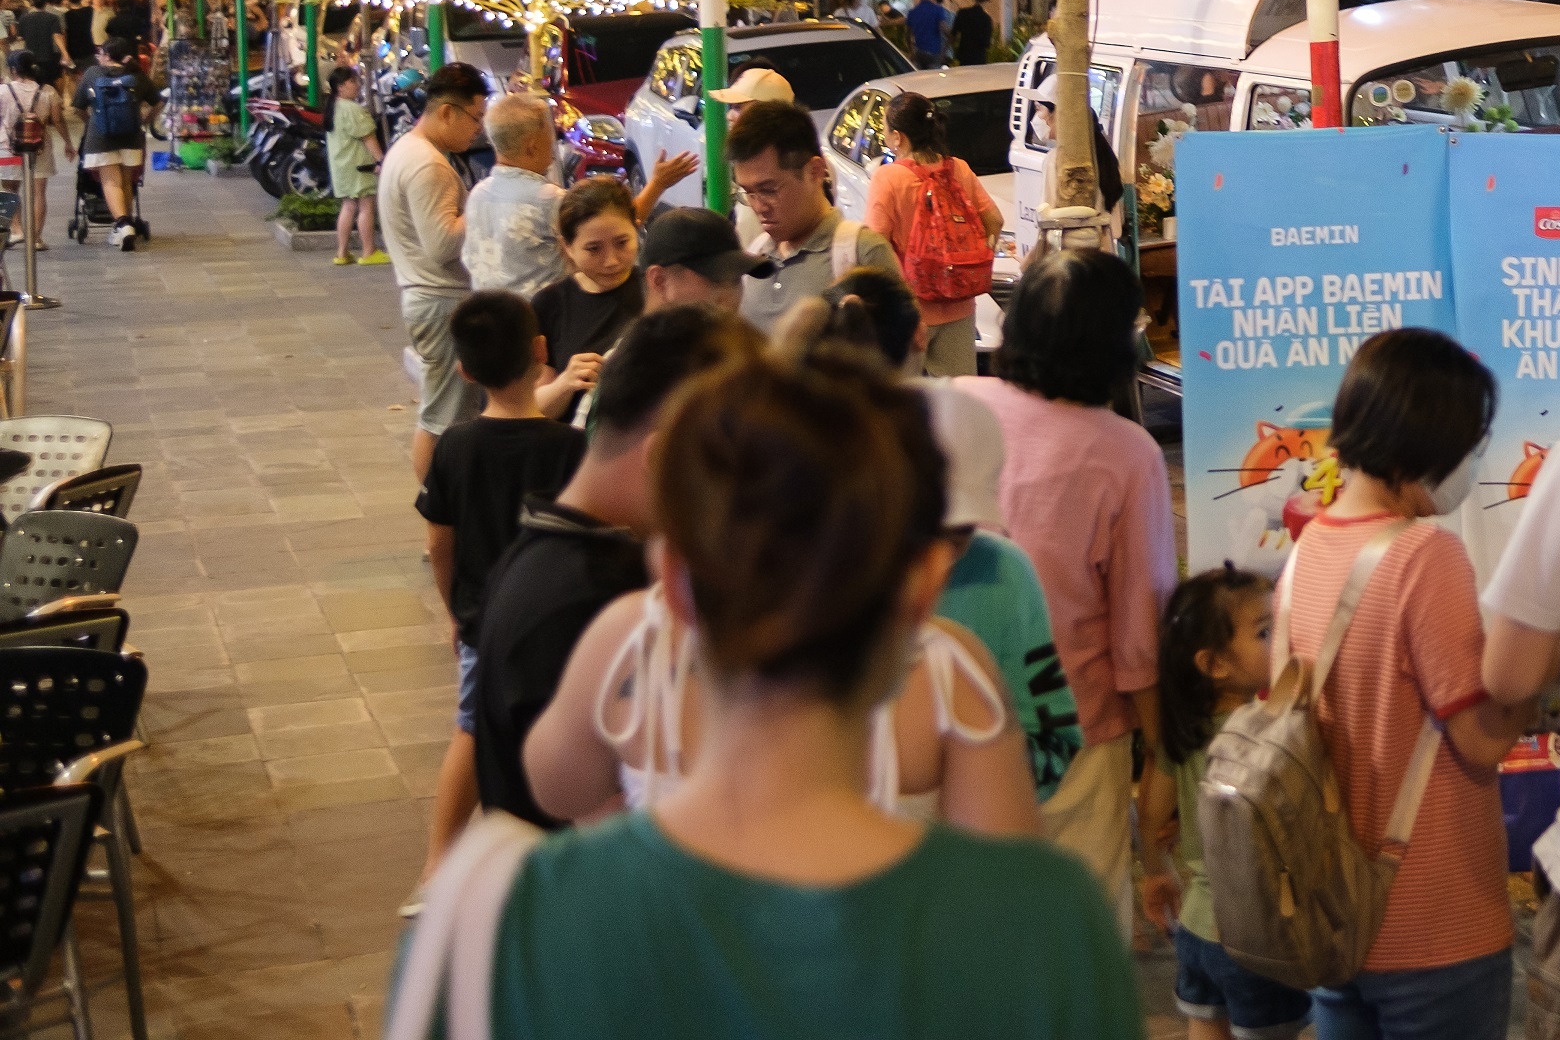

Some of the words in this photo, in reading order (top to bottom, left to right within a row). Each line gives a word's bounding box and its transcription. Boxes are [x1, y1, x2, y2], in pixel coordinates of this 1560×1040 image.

[1270, 225, 1360, 247] BAEMIN
[1252, 276, 1315, 306] APP
[1321, 270, 1443, 304] BAEMIN
[1233, 306, 1319, 338] NHẬN
[1285, 337, 1331, 367] ĂN
[1516, 350, 1559, 379] ĂN
